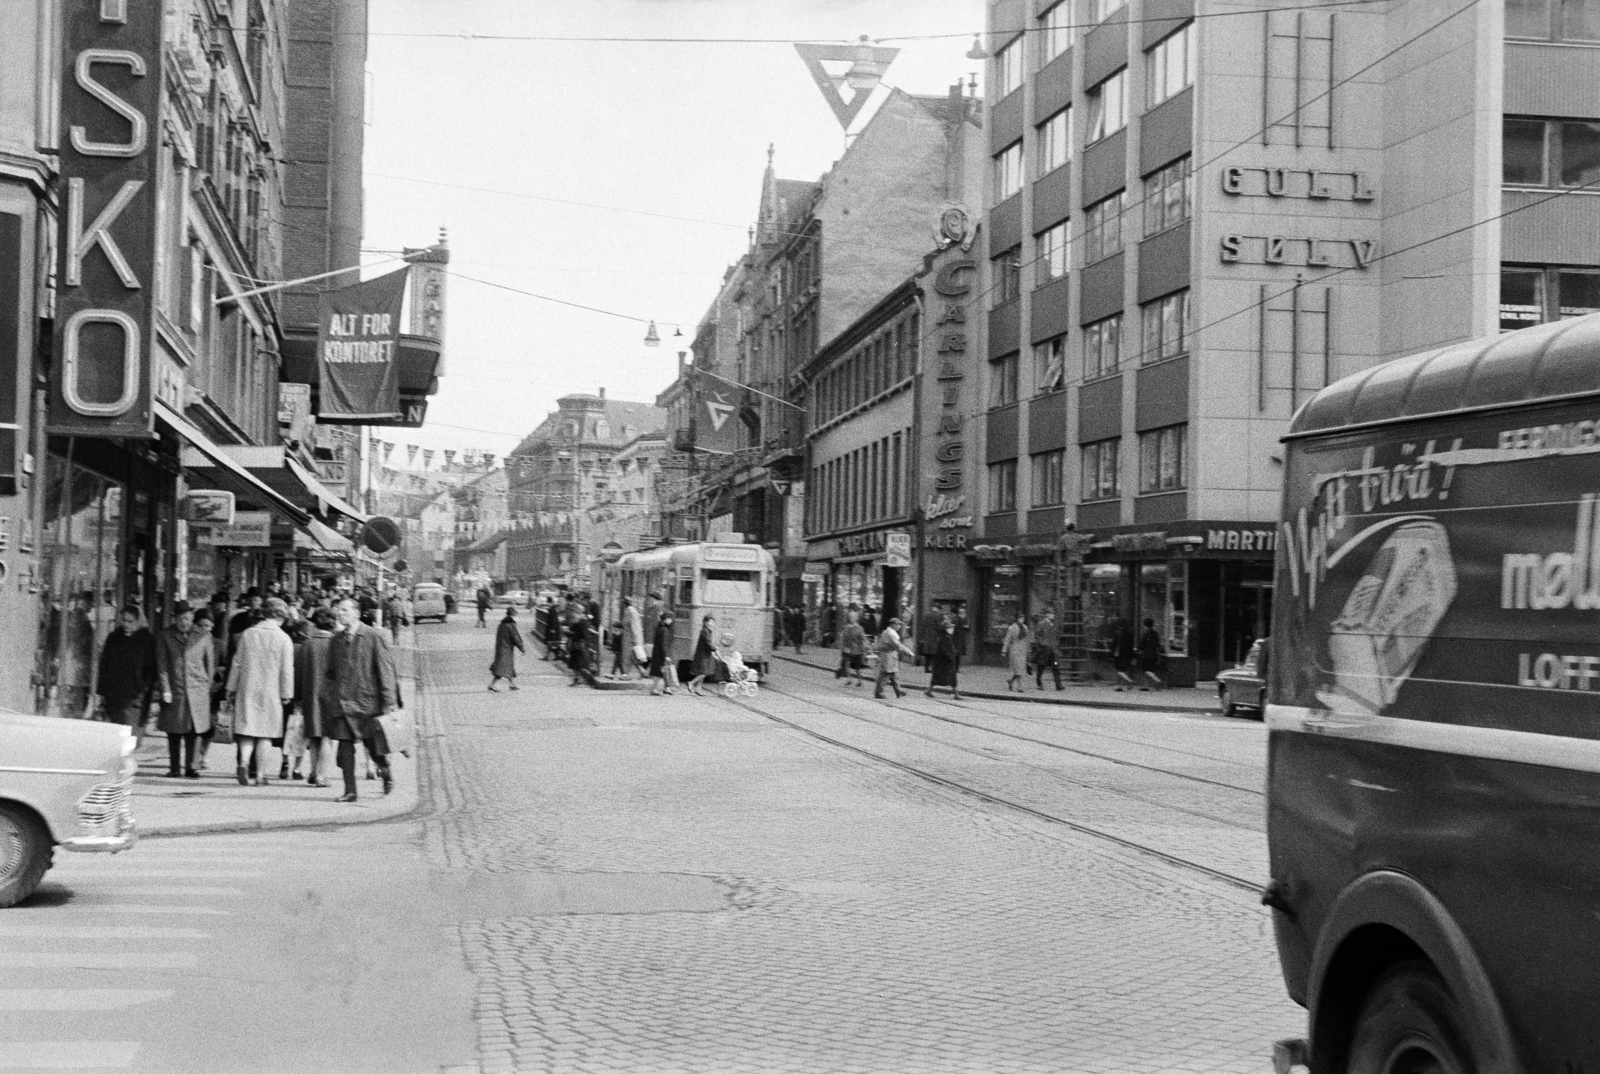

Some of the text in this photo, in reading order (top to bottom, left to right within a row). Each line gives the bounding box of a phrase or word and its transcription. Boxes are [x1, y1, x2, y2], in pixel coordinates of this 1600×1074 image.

[1222, 167, 1375, 201] GULL
[1220, 233, 1378, 270] SØLV
[329, 313, 391, 336] ALT FOR
[324, 340, 393, 363] KONTORET
[934, 259, 977, 490] CARLINGS
[925, 534, 967, 548] KLER
